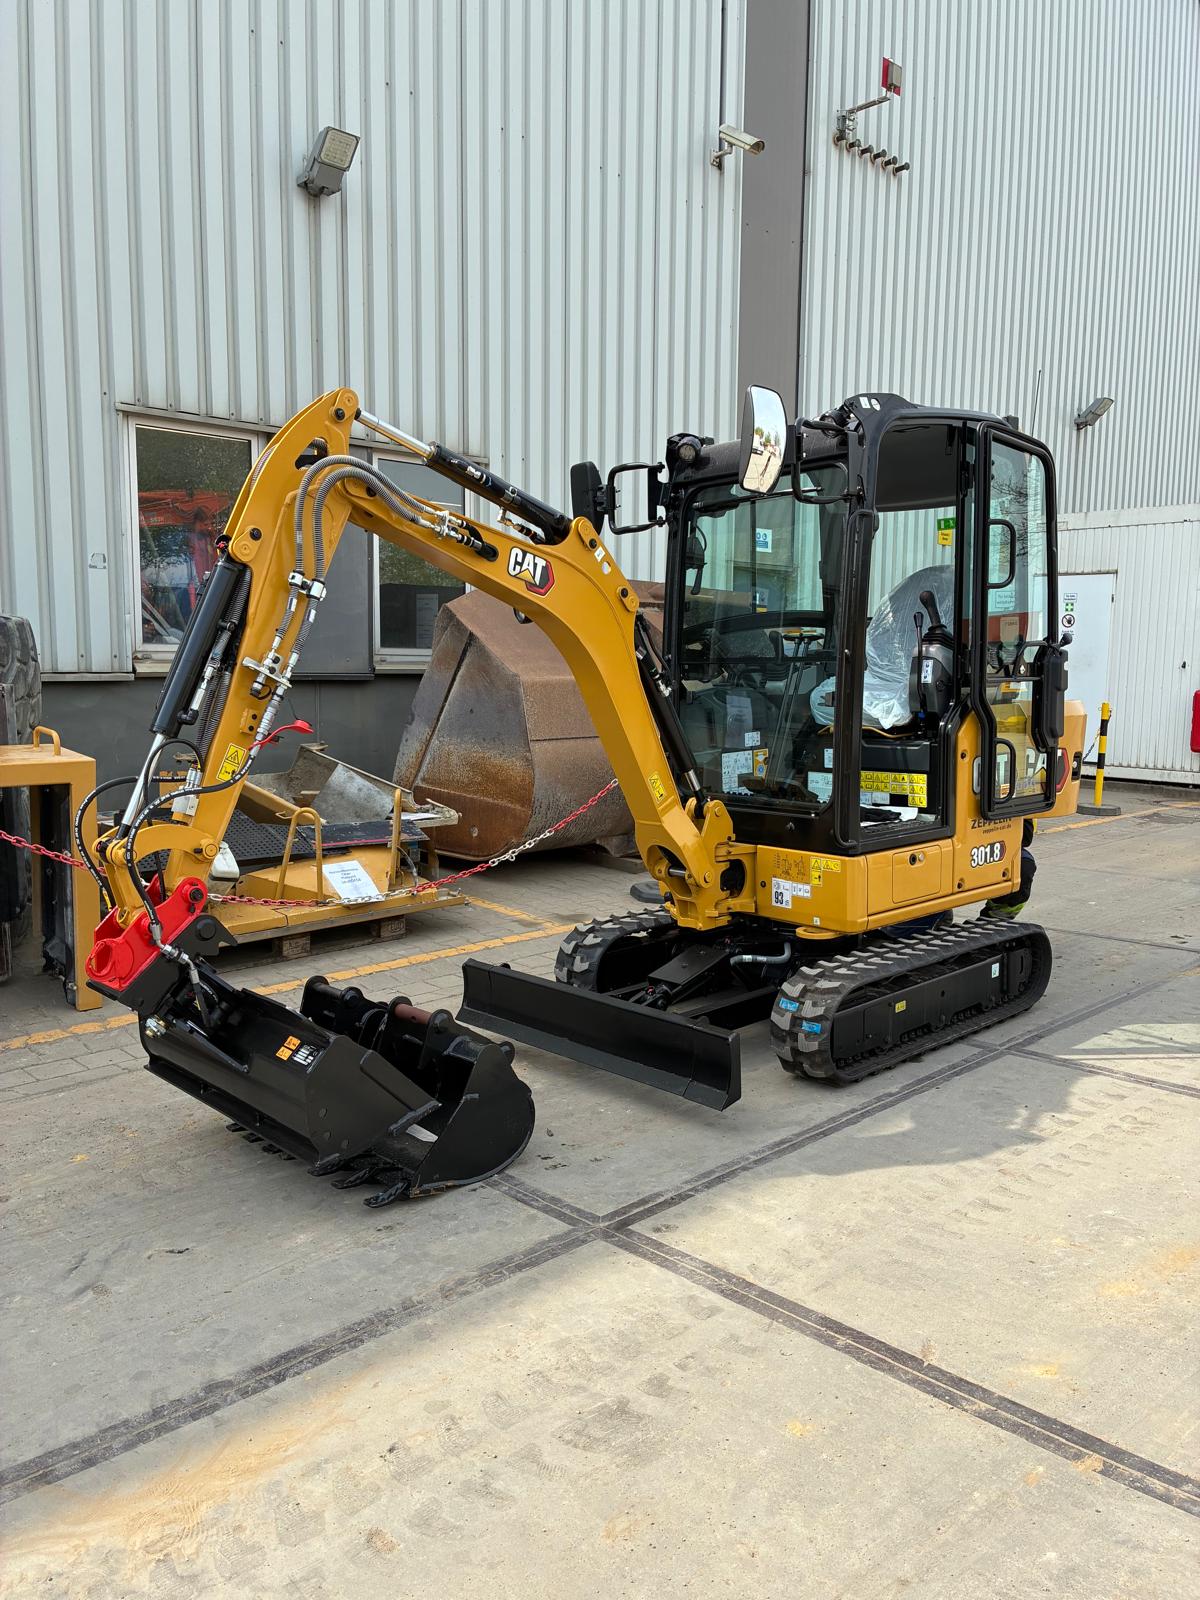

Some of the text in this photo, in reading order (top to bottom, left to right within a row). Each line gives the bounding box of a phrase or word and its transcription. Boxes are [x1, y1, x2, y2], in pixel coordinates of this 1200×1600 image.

[508, 547, 547, 586] CAT
[1025, 748, 1063, 778] CA
[971, 842, 1001, 868] 301.8
[774, 890, 784, 905] 93
